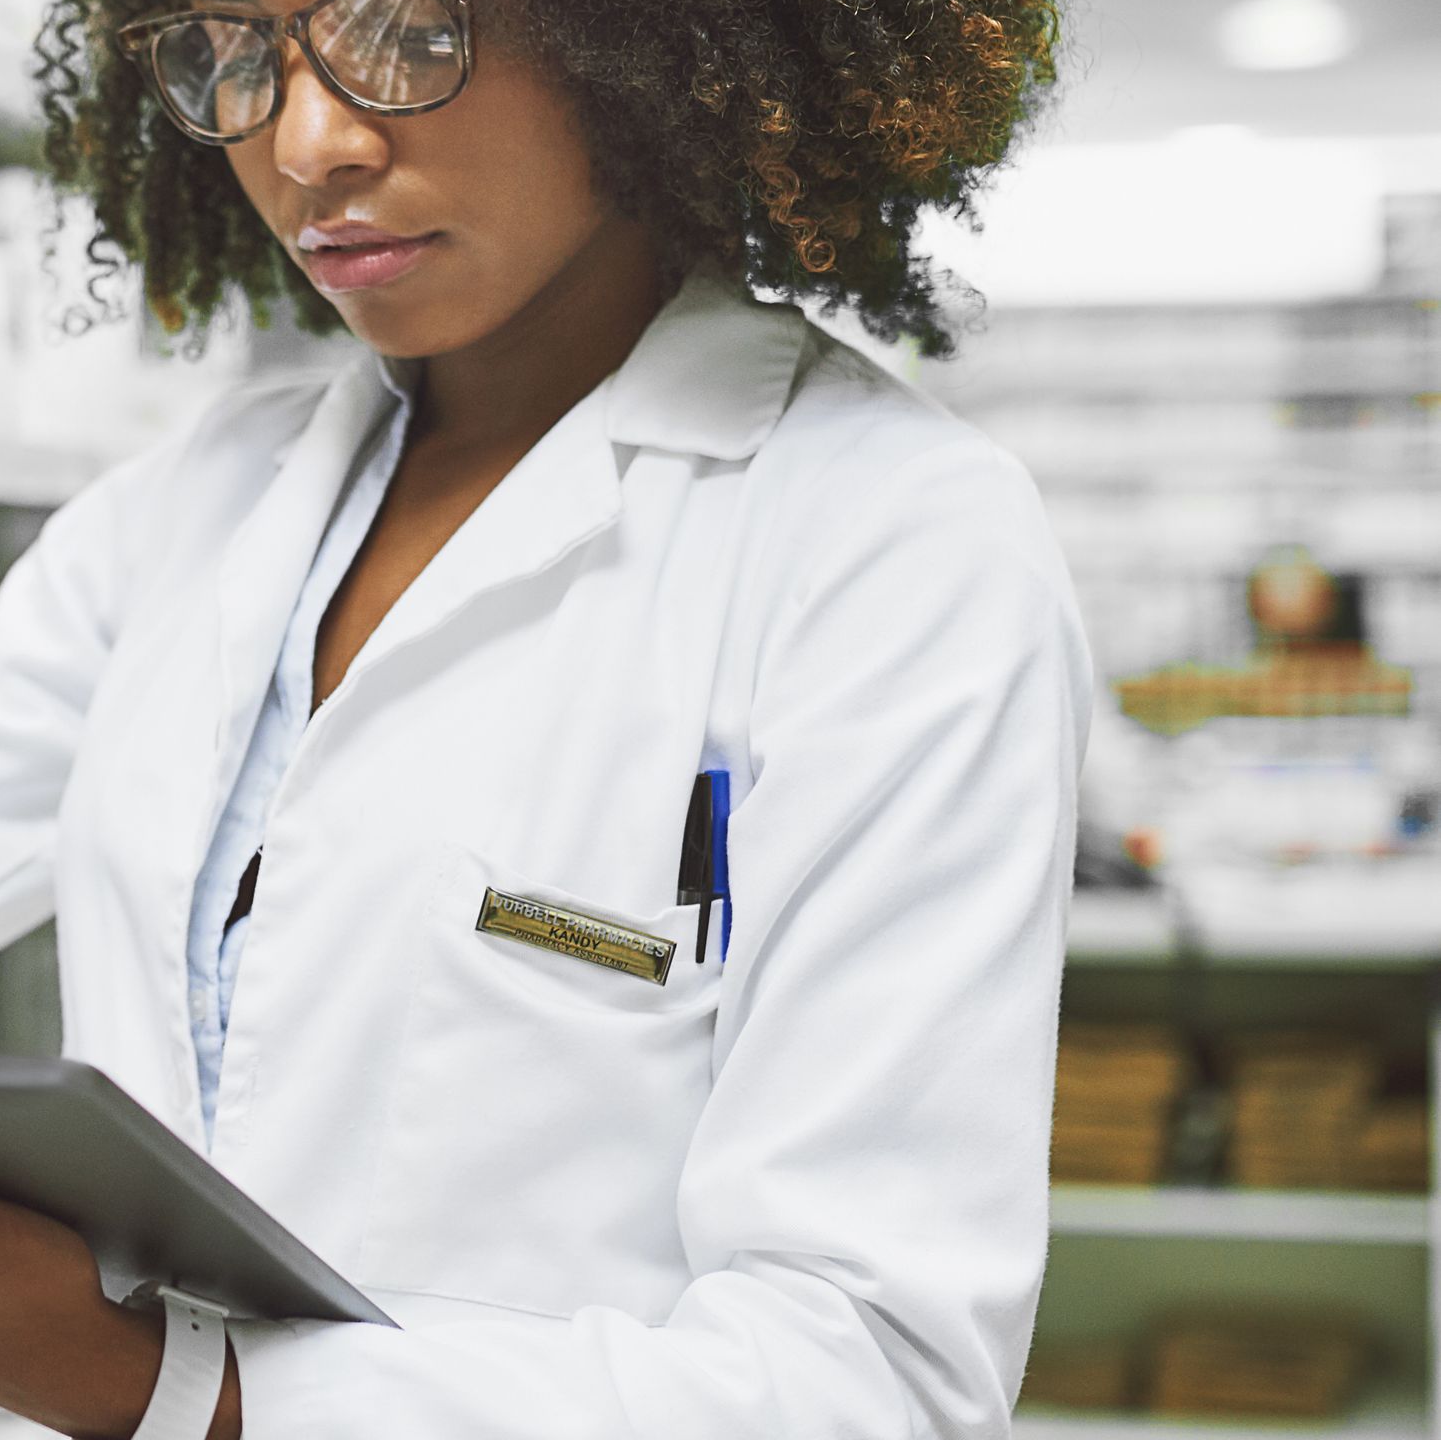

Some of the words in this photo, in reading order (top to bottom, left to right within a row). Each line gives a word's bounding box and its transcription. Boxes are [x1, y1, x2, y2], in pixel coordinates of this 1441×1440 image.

[492, 893, 561, 928] DURBELL
[565, 916, 666, 958] PHARMACIES
[548, 926, 602, 951] KANDY
[514, 928, 571, 952] PHARMACY
[573, 948, 630, 970] ASSISTANT
